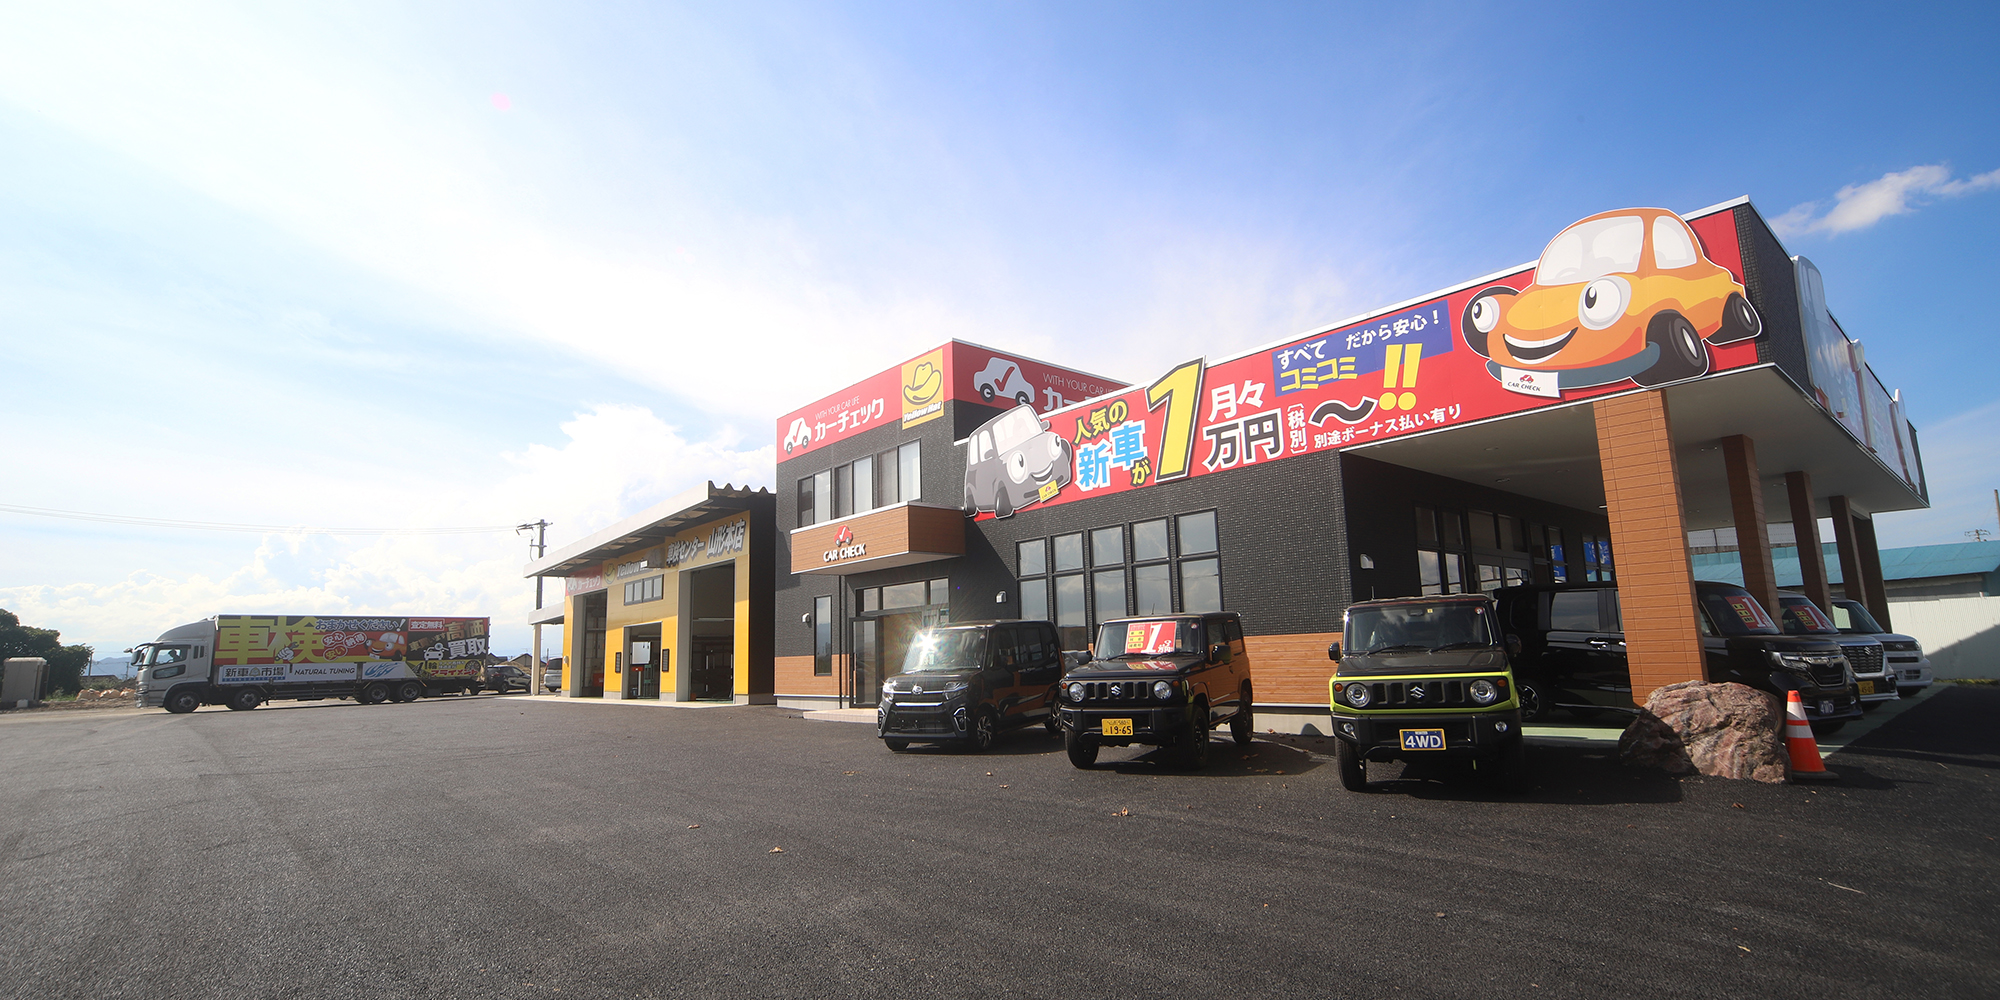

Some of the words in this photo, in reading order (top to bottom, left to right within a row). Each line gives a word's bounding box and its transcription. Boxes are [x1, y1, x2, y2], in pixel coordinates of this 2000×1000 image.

[1277, 340, 1327, 370] すべて
[1043, 373, 1064, 386] WITH
[1066, 379, 1087, 392] YOUR
[1089, 384, 1103, 395] CAR
[1280, 356, 1358, 392] コミコミ
[815, 410, 828, 421] WITH
[827, 403, 842, 416] YOUR
[841, 399, 852, 411] CAR
[852, 395, 861, 406] LIFE
[903, 408, 928, 424] Yellow
[926, 400, 943, 416] Hat
[1208, 379, 1266, 423] 月々
[814, 397, 884, 442] カーチェック
[1072, 398, 1129, 447] 人気の
[1145, 355, 1206, 483] 1
[1314, 403, 1462, 449] 別途ボーナス払い有り
[1202, 408, 1284, 472] 万円
[666, 536, 706, 565] 車検センター
[707, 519, 746, 557] 山形本店
[823, 549, 840, 563] CAR
[840, 543, 867, 560] CHECK
[577, 575, 601, 591] カーチェック
[410, 620, 444, 630] 査定無料
[444, 619, 485, 641] 高価
[215, 615, 330, 665] 車検
[323, 632, 344, 645] 安心
[447, 637, 487, 660] 買取
[1140, 623, 1163, 653] 1
[325, 647, 346, 660] 安い
[294, 668, 327, 676] NATURAL
[329, 667, 355, 675] TUNING
[430, 669, 478, 677] アライメント
[1404, 735, 1442, 748] 4WD
